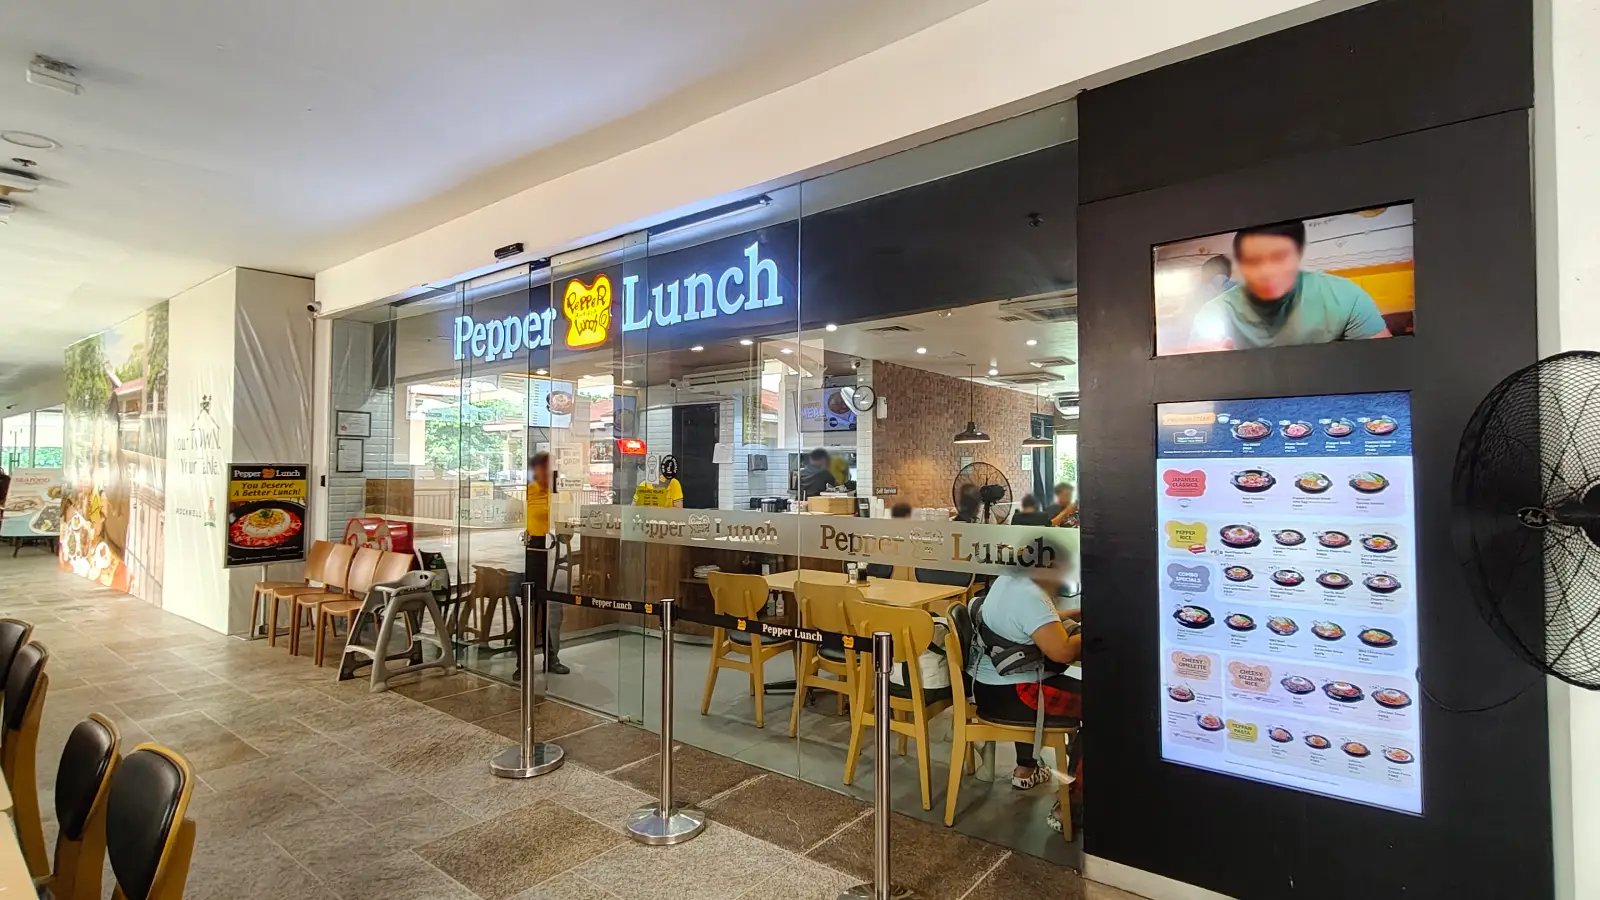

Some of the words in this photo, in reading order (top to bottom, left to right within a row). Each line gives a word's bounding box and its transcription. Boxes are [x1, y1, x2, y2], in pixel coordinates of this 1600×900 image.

[453, 307, 556, 362] Pepper
[621, 240, 783, 332] Lunch
[233, 469, 261, 478] Pepper
[275, 469, 300, 477] Lunch
[242, 489, 271, 497] Better
[272, 488, 301, 496] Lunch!
[714, 517, 779, 546] Lunch
[819, 524, 904, 557] Pepper
[951, 533, 1056, 569] Lunch
[592, 597, 612, 608] Pepper
[613, 599, 632, 610] Lunch
[762, 623, 792, 637] Pepper
[794, 628, 823, 642] Lunch
